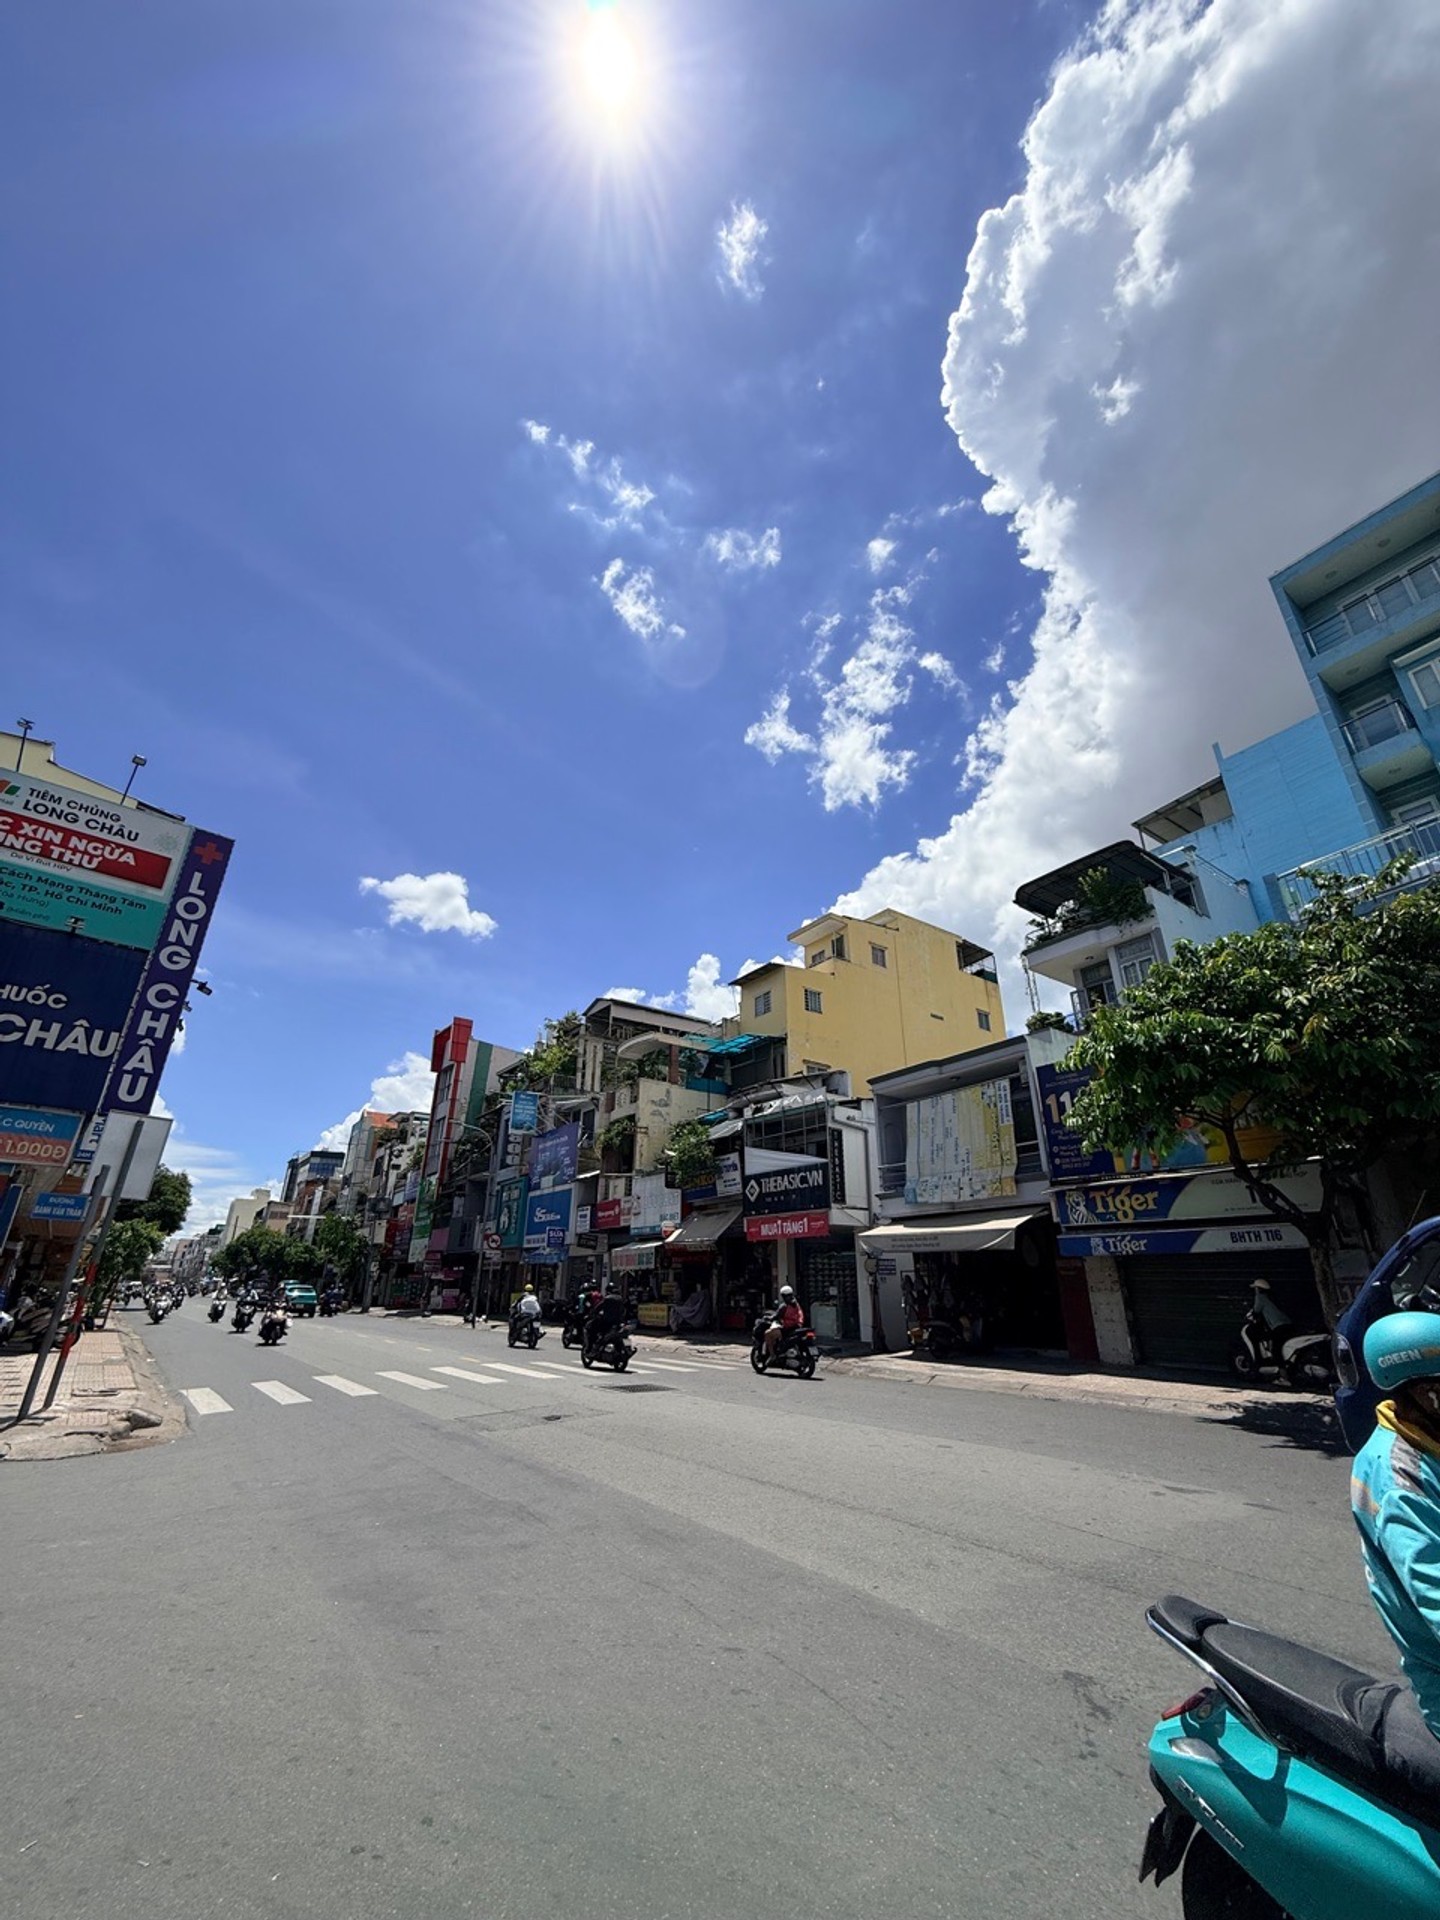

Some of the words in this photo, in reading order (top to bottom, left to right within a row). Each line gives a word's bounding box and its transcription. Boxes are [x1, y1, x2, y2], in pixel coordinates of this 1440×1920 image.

[28, 787, 63, 806] TIÊM
[22, 799, 79, 824] LONG
[85, 817, 140, 842] CHÂU
[17, 821, 64, 845] XIN
[68, 835, 136, 866] NGỪA
[50, 846, 103, 869] THƯ
[21, 883, 40, 895] TP.
[90, 900, 123, 915] Minh
[36, 875, 74, 893] Mạng
[158, 871, 207, 971] LONG
[0, 1012, 120, 1058] CHÂU
[117, 982, 180, 1103] CHÂU
[1089, 1184, 1159, 1224] Tiger
[1105, 1235, 1148, 1255] Tiger
[1230, 1230, 1262, 1244] BHTH
[1263, 1228, 1284, 1242] 116
[1377, 1348, 1422, 1368] GREEN
